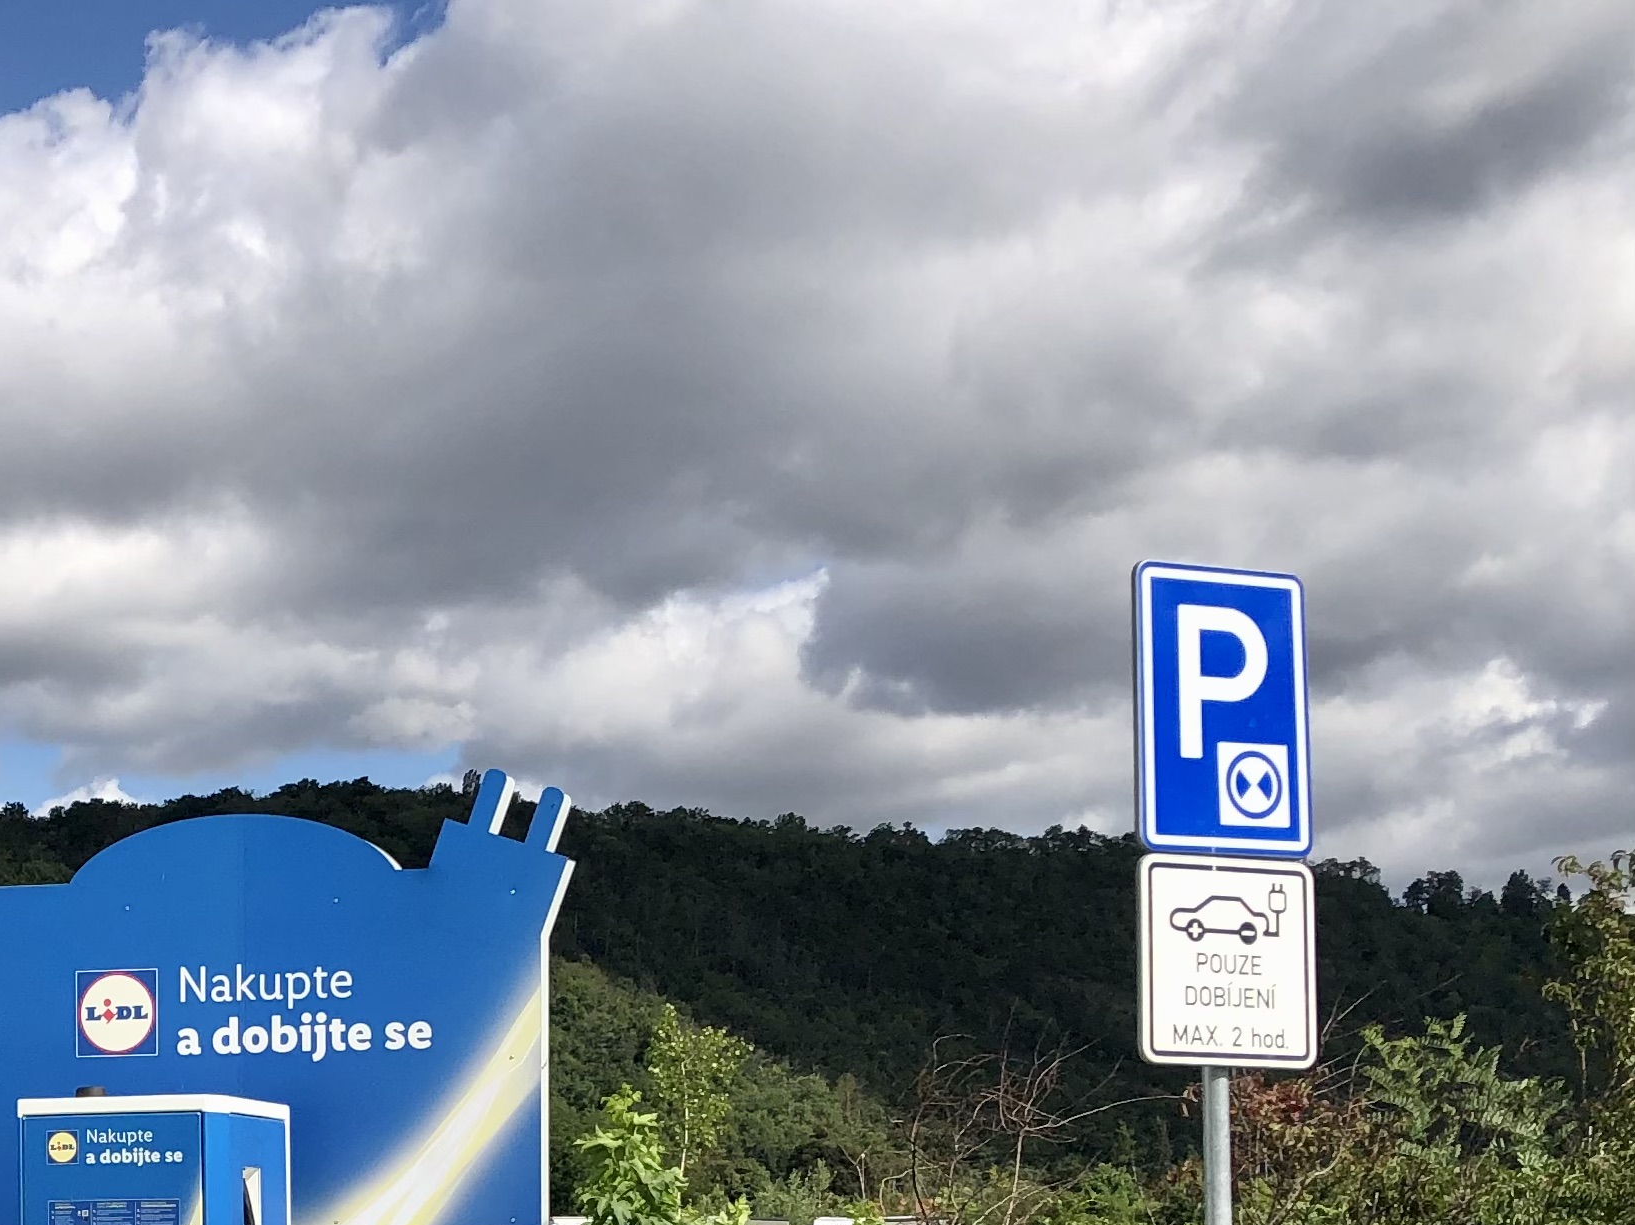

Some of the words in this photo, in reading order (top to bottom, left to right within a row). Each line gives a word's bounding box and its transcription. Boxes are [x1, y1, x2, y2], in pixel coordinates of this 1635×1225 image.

[1177, 603, 1269, 759] P
[1196, 952, 1262, 976] POUZE
[178, 963, 354, 1009] Nakupte
[1185, 981, 1277, 1010] DOBÍJENÍ
[176, 1027, 202, 1056] a
[212, 1011, 372, 1062] dobijte
[384, 1019, 433, 1050] se
[1172, 1023, 1223, 1047] MAX.
[1232, 1026, 1243, 1048] 2
[1251, 1027, 1289, 1050] hod.
[86, 1128, 154, 1147] Nakupte
[85, 1152, 97, 1165] a
[99, 1147, 161, 1167] dobijte
[164, 1150, 184, 1163] se
